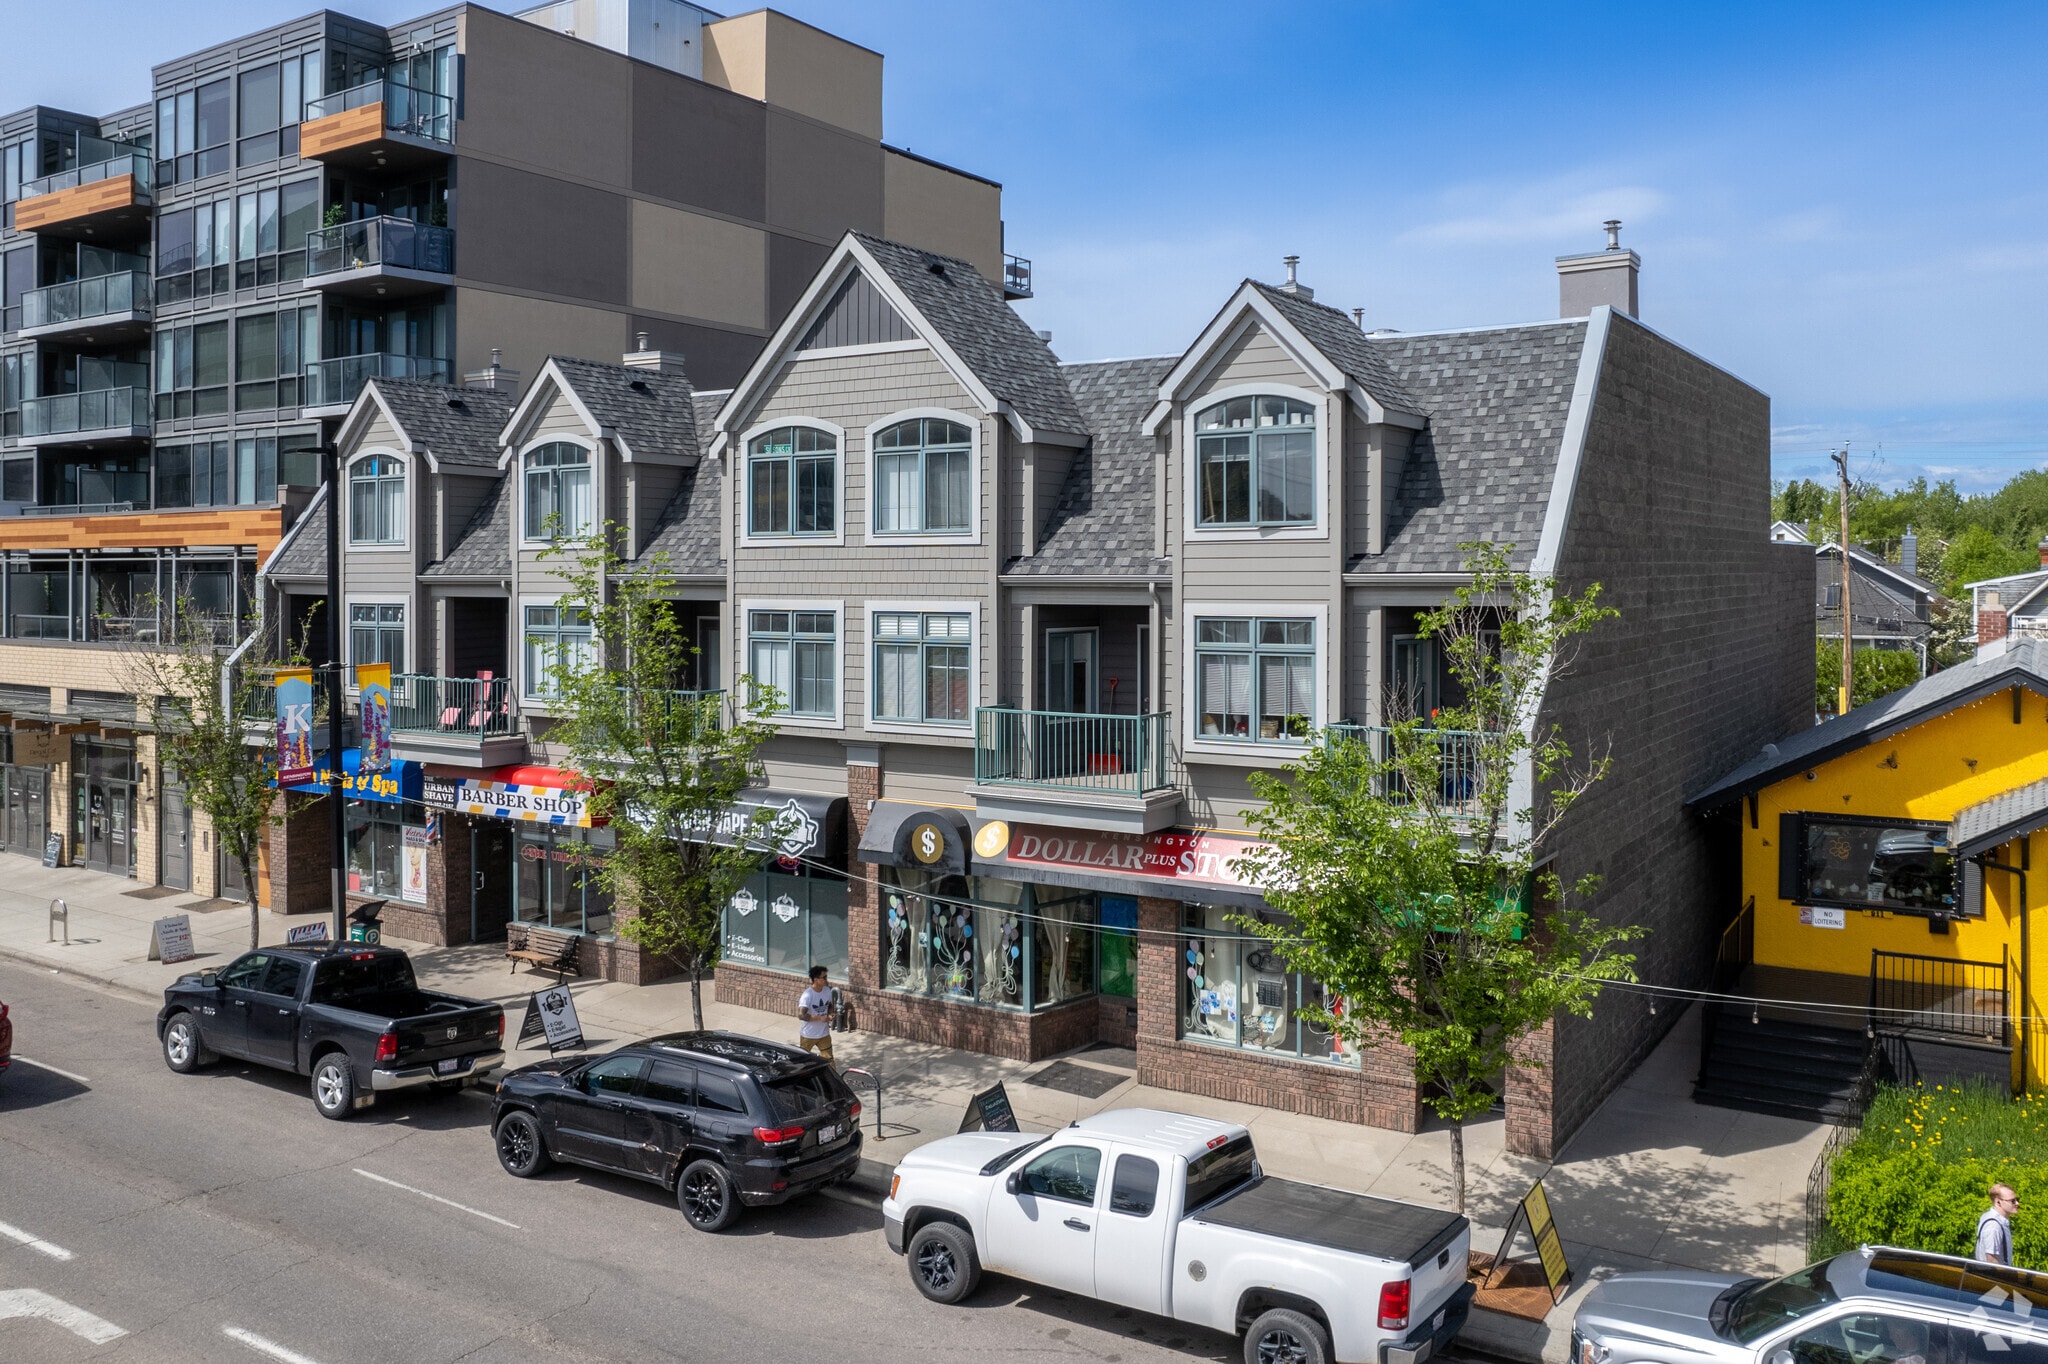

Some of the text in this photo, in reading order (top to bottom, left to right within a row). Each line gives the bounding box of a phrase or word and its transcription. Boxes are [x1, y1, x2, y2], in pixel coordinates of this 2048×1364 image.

[282, 703, 311, 734] K
[371, 774, 399, 797] Spa
[424, 782, 456, 794] URBAN
[424, 790, 454, 802] SHAVE
[461, 788, 529, 809] BARBER
[533, 797, 583, 815] SHOP
[1101, 831, 1211, 849] KENSINGTON
[1017, 835, 1145, 870] DOLLAR
[1143, 853, 1177, 867] PLUS
[1814, 918, 1843, 927] LOITERING
[731, 949, 765, 963] Accessories
